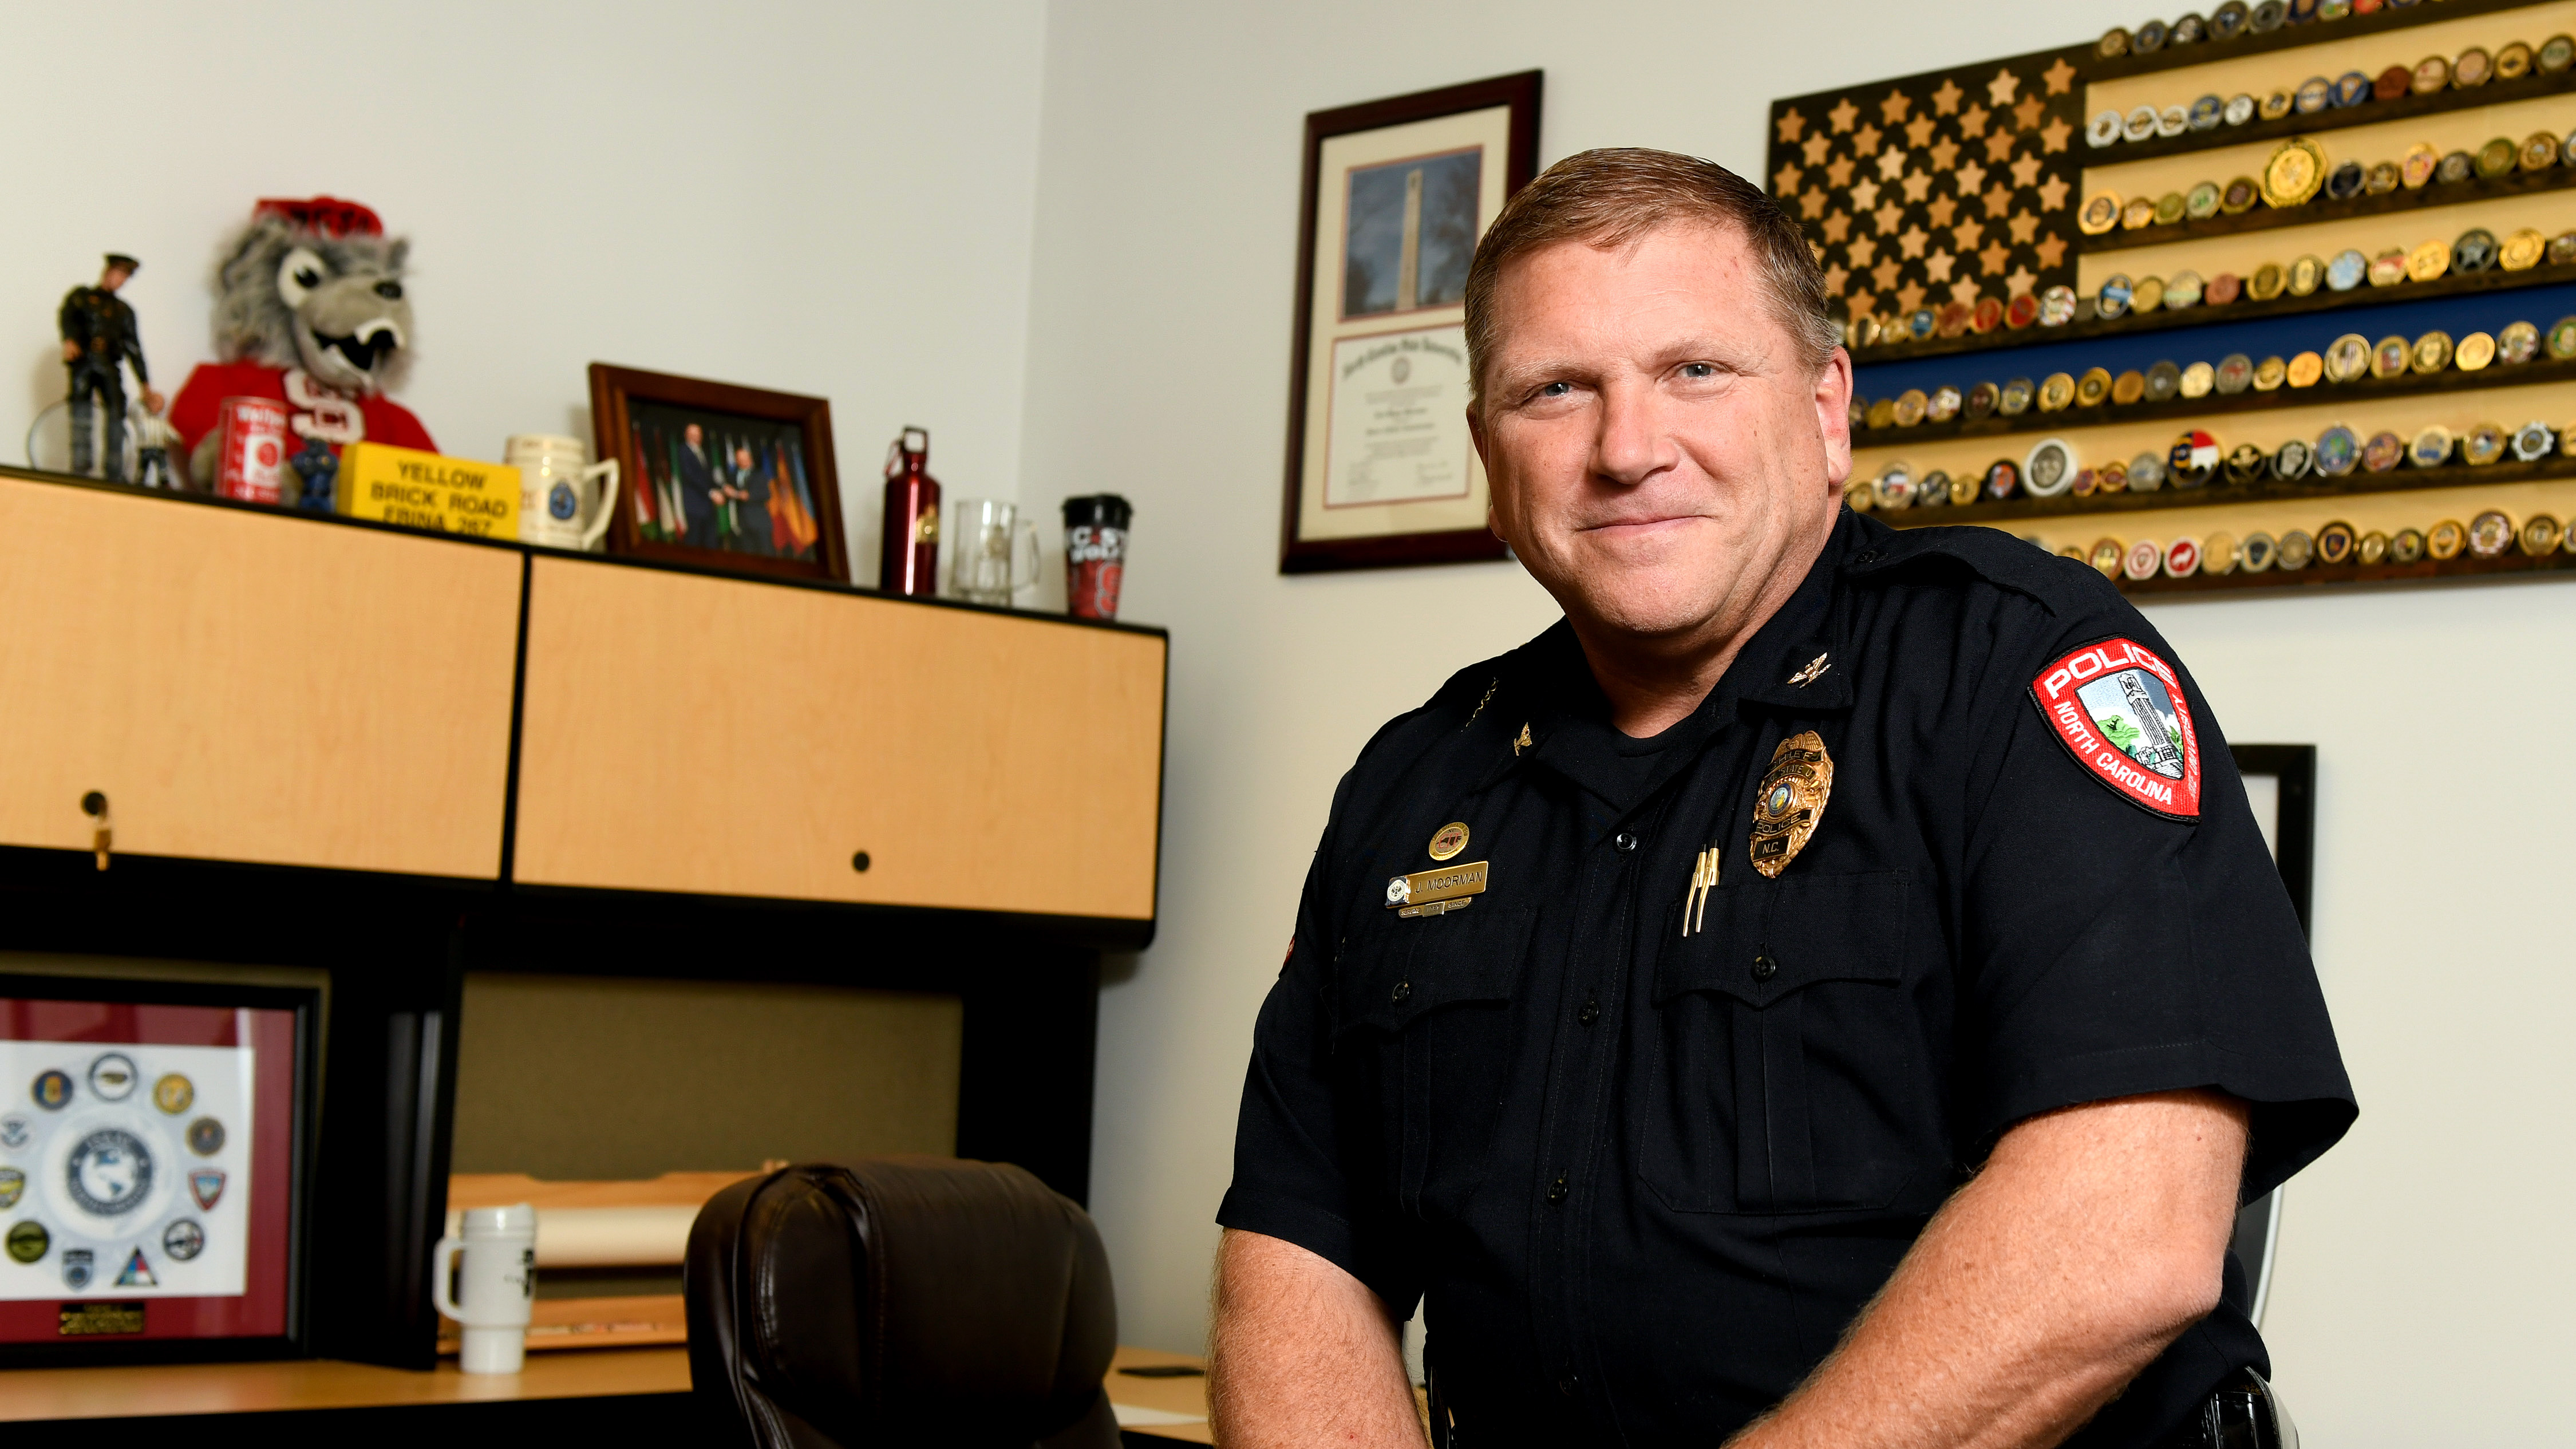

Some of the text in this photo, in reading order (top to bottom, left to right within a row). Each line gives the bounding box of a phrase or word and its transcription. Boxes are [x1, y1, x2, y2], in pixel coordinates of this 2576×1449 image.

[398, 460, 486, 489] YELLOW
[370, 480, 437, 507] BRICK
[448, 491, 508, 519] ROAD
[2044, 643, 2177, 700] POLICE
[1768, 750, 1814, 771] CHIEF
[2054, 701, 2172, 805] NORTH CAROLINA
[1780, 765, 1804, 775] STATE
[1756, 813, 1801, 834] POLICE
[1437, 832, 1462, 848] CIT
[1762, 842, 1779, 855] N.C.
[1415, 882, 1423, 894] J.
[1427, 871, 1483, 892] MOORMAN
[1448, 899, 1467, 909] SINCE
